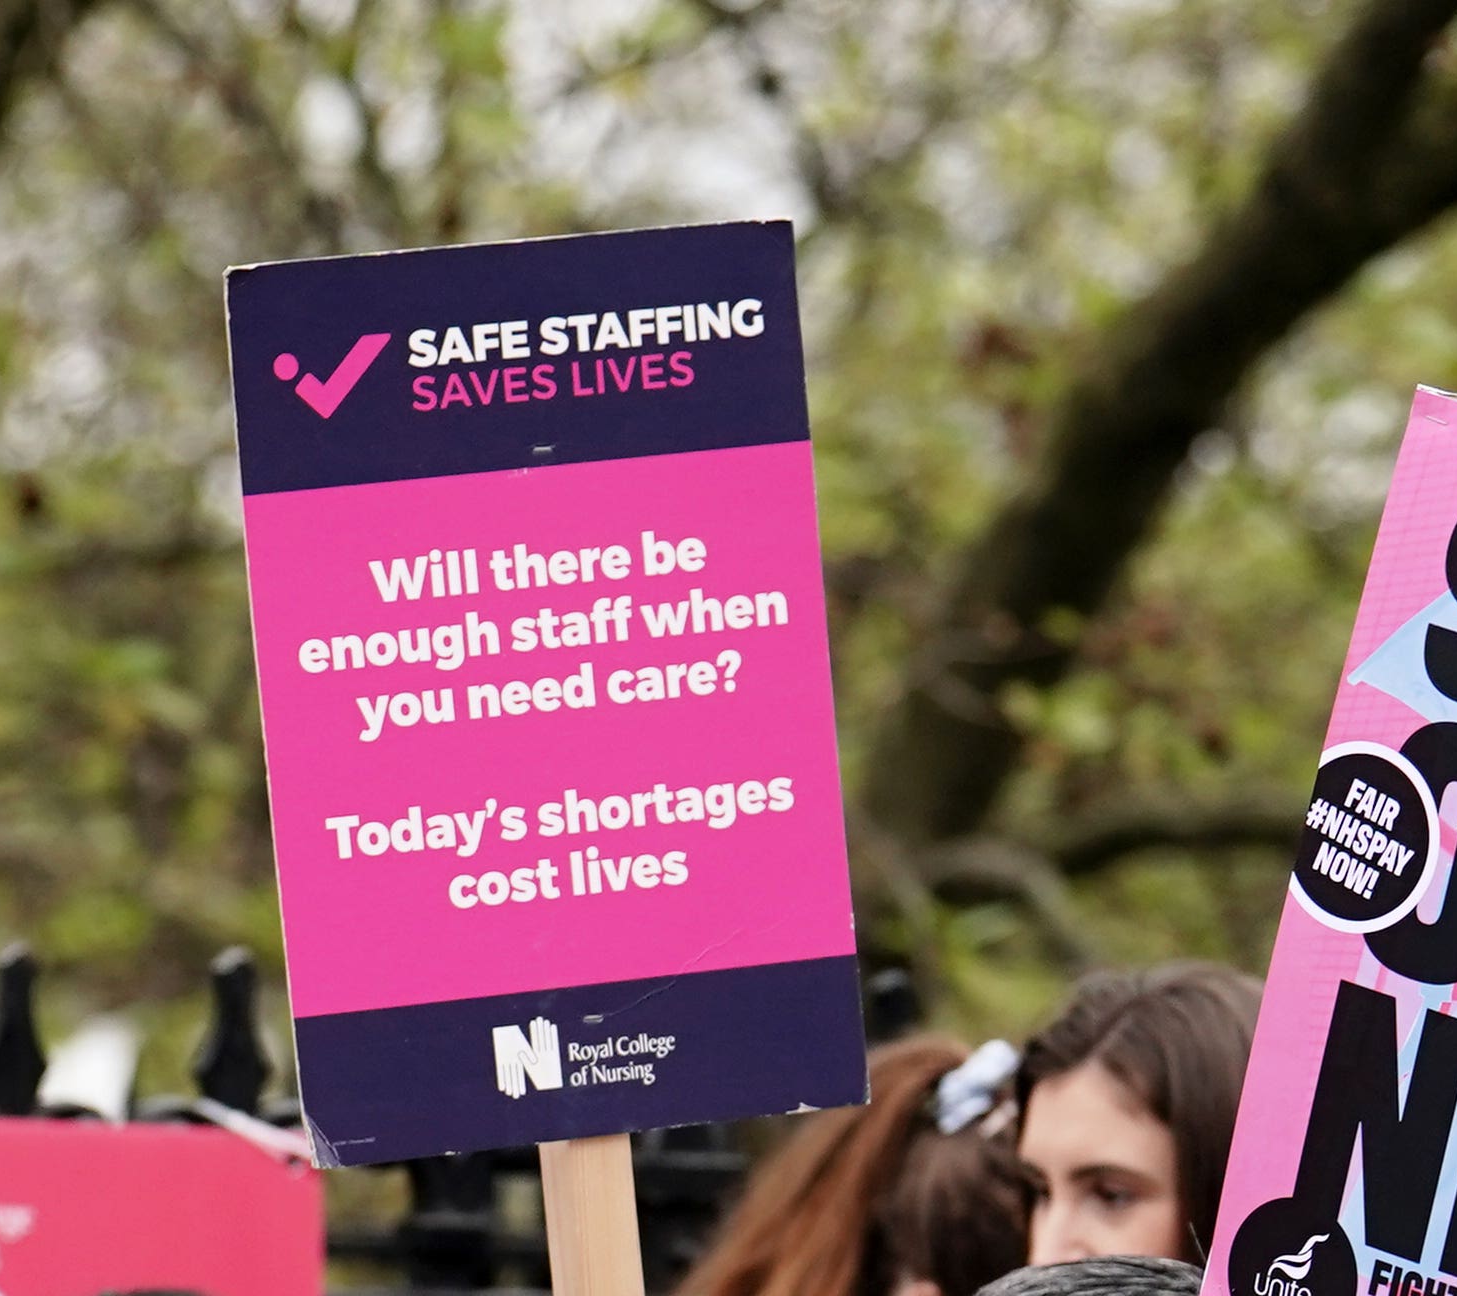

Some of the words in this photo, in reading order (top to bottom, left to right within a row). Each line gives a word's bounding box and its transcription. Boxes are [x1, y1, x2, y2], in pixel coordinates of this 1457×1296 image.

[408, 321, 530, 368] SAFE
[539, 299, 764, 356] STAFFING
[411, 364, 557, 412] SAVES
[572, 351, 695, 397] LIVES
[369, 548, 480, 602] Will
[490, 542, 631, 592] there
[641, 531, 707, 576] be
[297, 613, 500, 674] enough
[511, 596, 632, 653] staff
[641, 588, 788, 639] when
[357, 692, 455, 741] you
[467, 662, 595, 722] need
[607, 650, 742, 704] care?
[325, 798, 527, 859] Today's
[538, 777, 795, 837] shortages
[1306, 798, 1414, 876] #NHSPAY
[1344, 778, 1400, 831] FAIR
[448, 859, 559, 909] cost
[569, 846, 688, 897] lives
[1312, 841, 1380, 900] NOW!
[568, 1038, 614, 1063] Royal
[617, 1033, 676, 1059] College
[570, 1063, 589, 1086] of
[591, 1060, 655, 1086] Nursing
